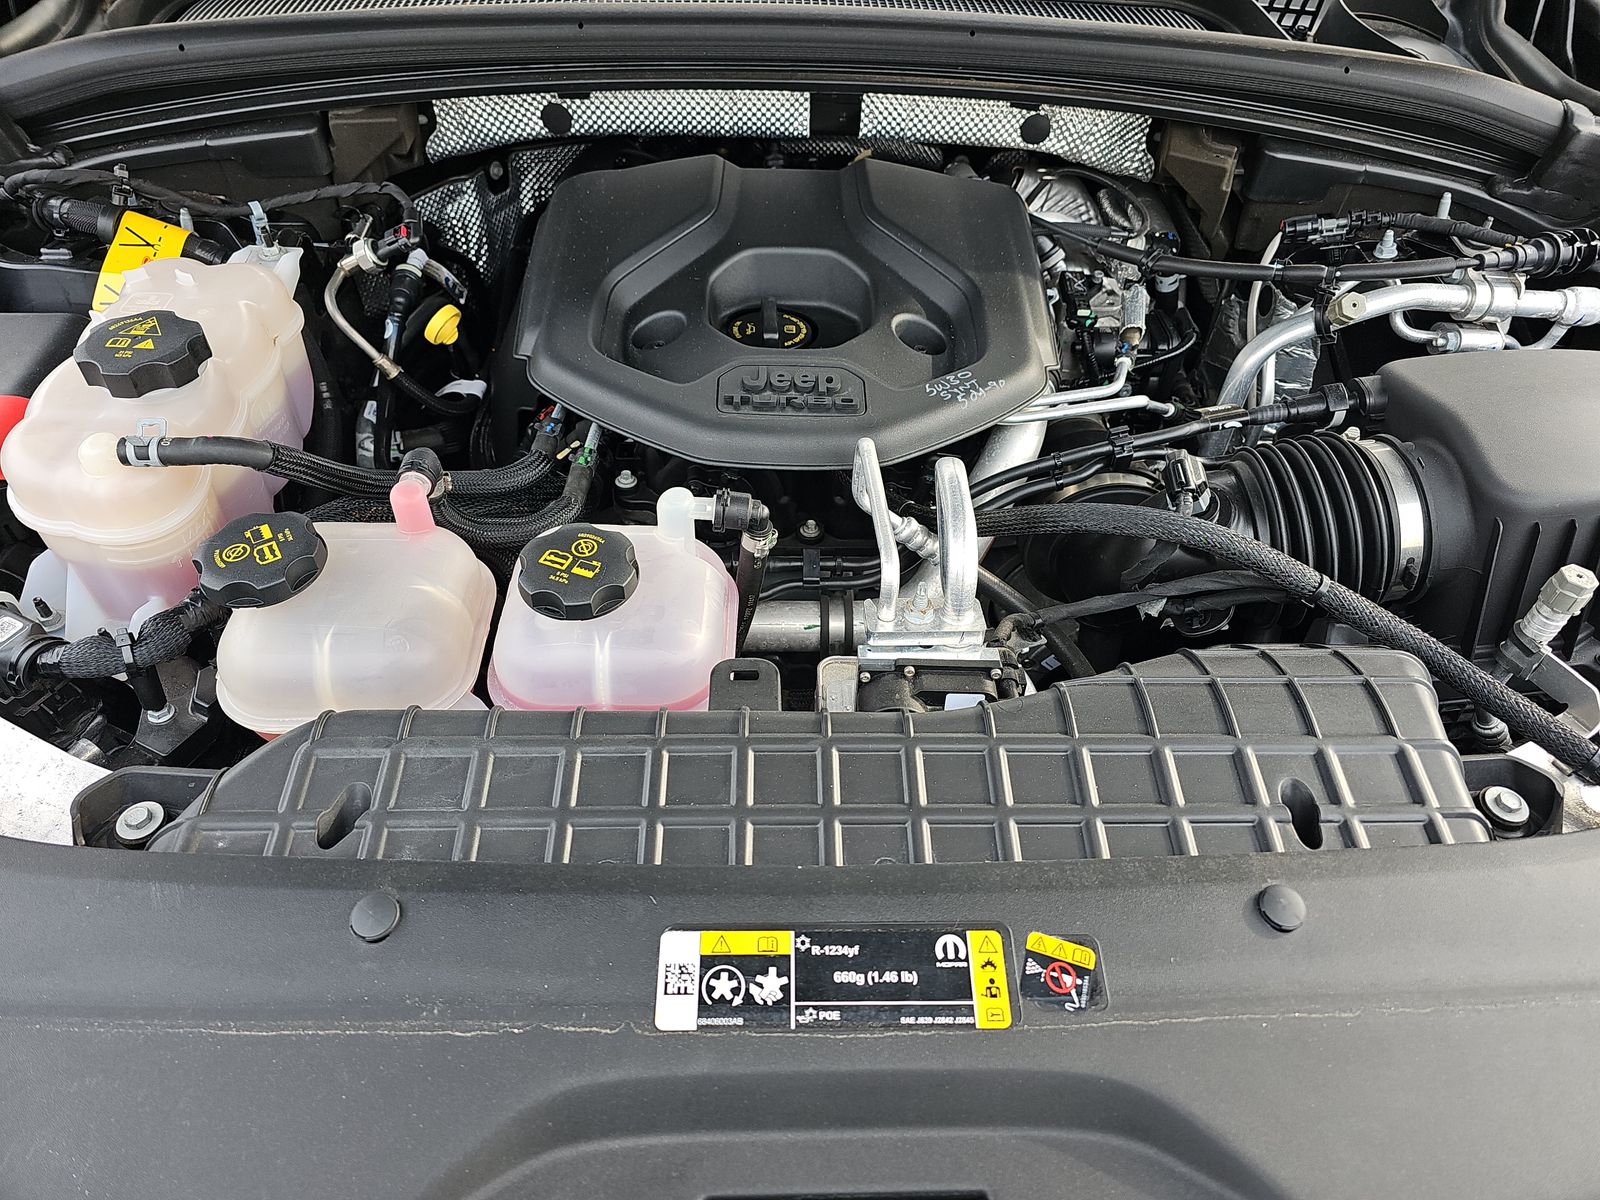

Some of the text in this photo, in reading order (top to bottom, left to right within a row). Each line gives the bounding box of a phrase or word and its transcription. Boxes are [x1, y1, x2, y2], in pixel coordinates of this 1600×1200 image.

[742, 366, 842, 395] Jeep
[925, 371, 972, 397] 5W30
[723, 394, 859, 412] TURBO
[811, 945, 861, 958] R-1234yf
[833, 971, 919, 986] 660g (1.46 lb)
[818, 1010, 842, 1021] POE
[900, 1016, 916, 1025] SAE
